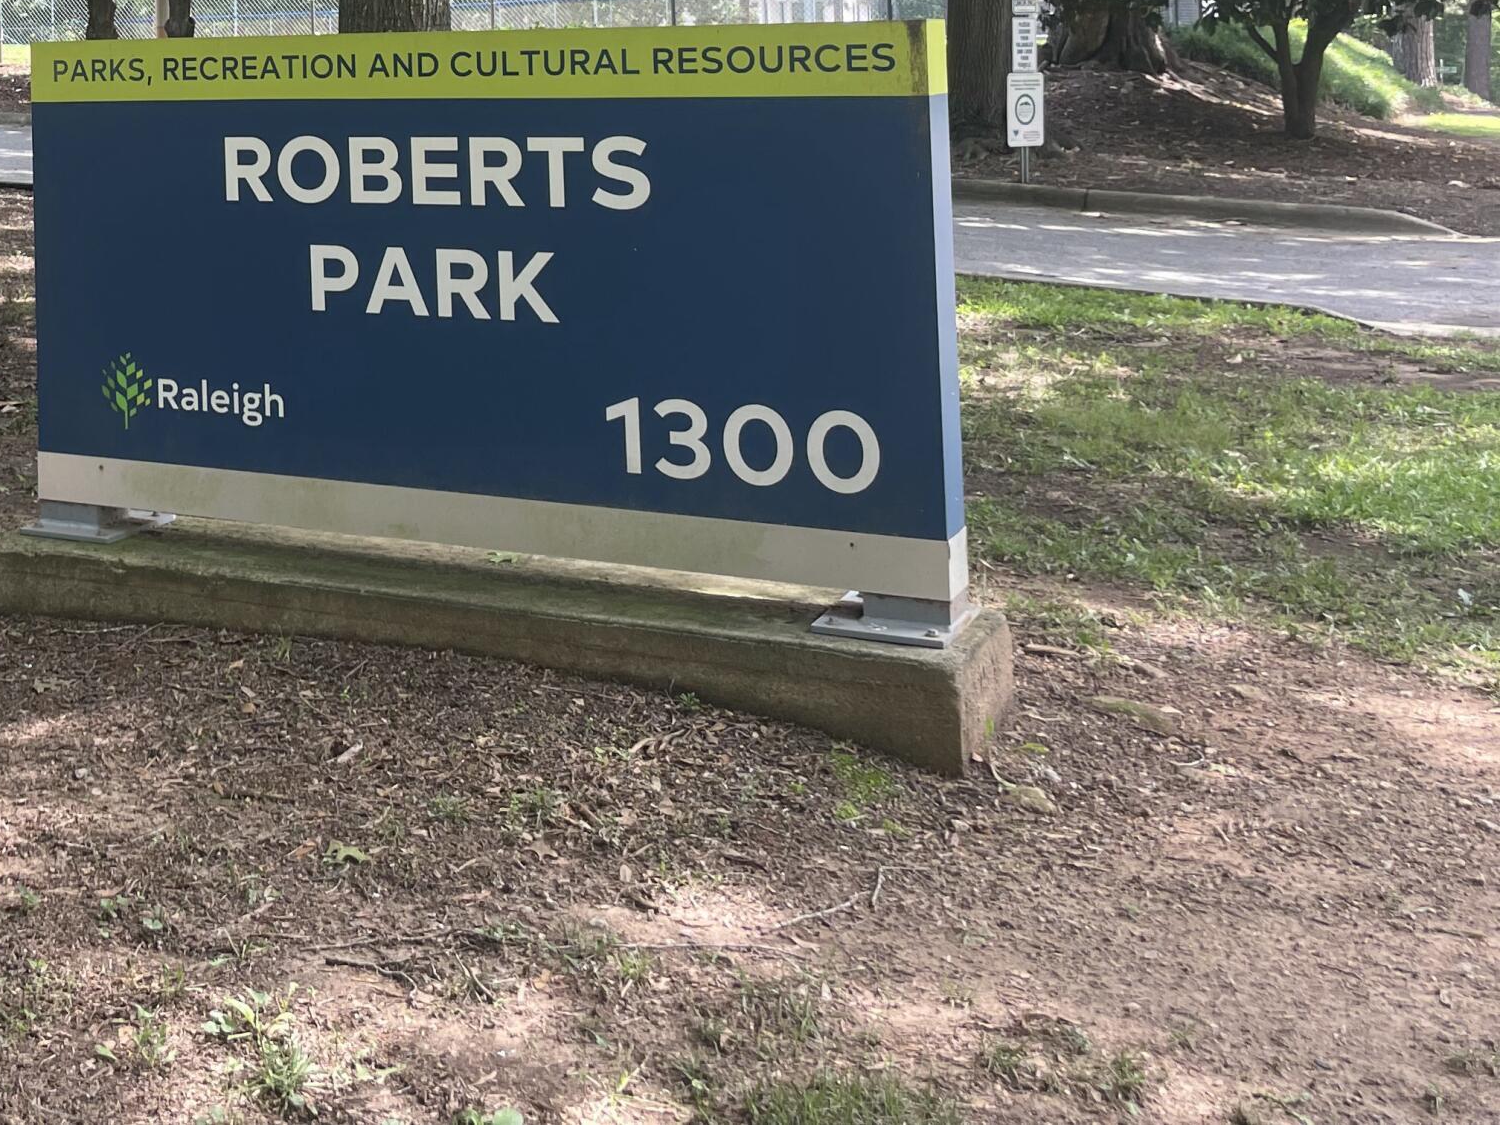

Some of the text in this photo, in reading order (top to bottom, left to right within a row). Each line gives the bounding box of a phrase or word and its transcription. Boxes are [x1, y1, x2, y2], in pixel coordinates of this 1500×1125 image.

[53, 44, 896, 86] PARKS, RECREATION AND CULTURAL RESOURCES
[224, 135, 651, 210] ROBERTS
[309, 244, 560, 324] PARK
[156, 378, 285, 427] Raleigh
[605, 397, 880, 494] 1300
